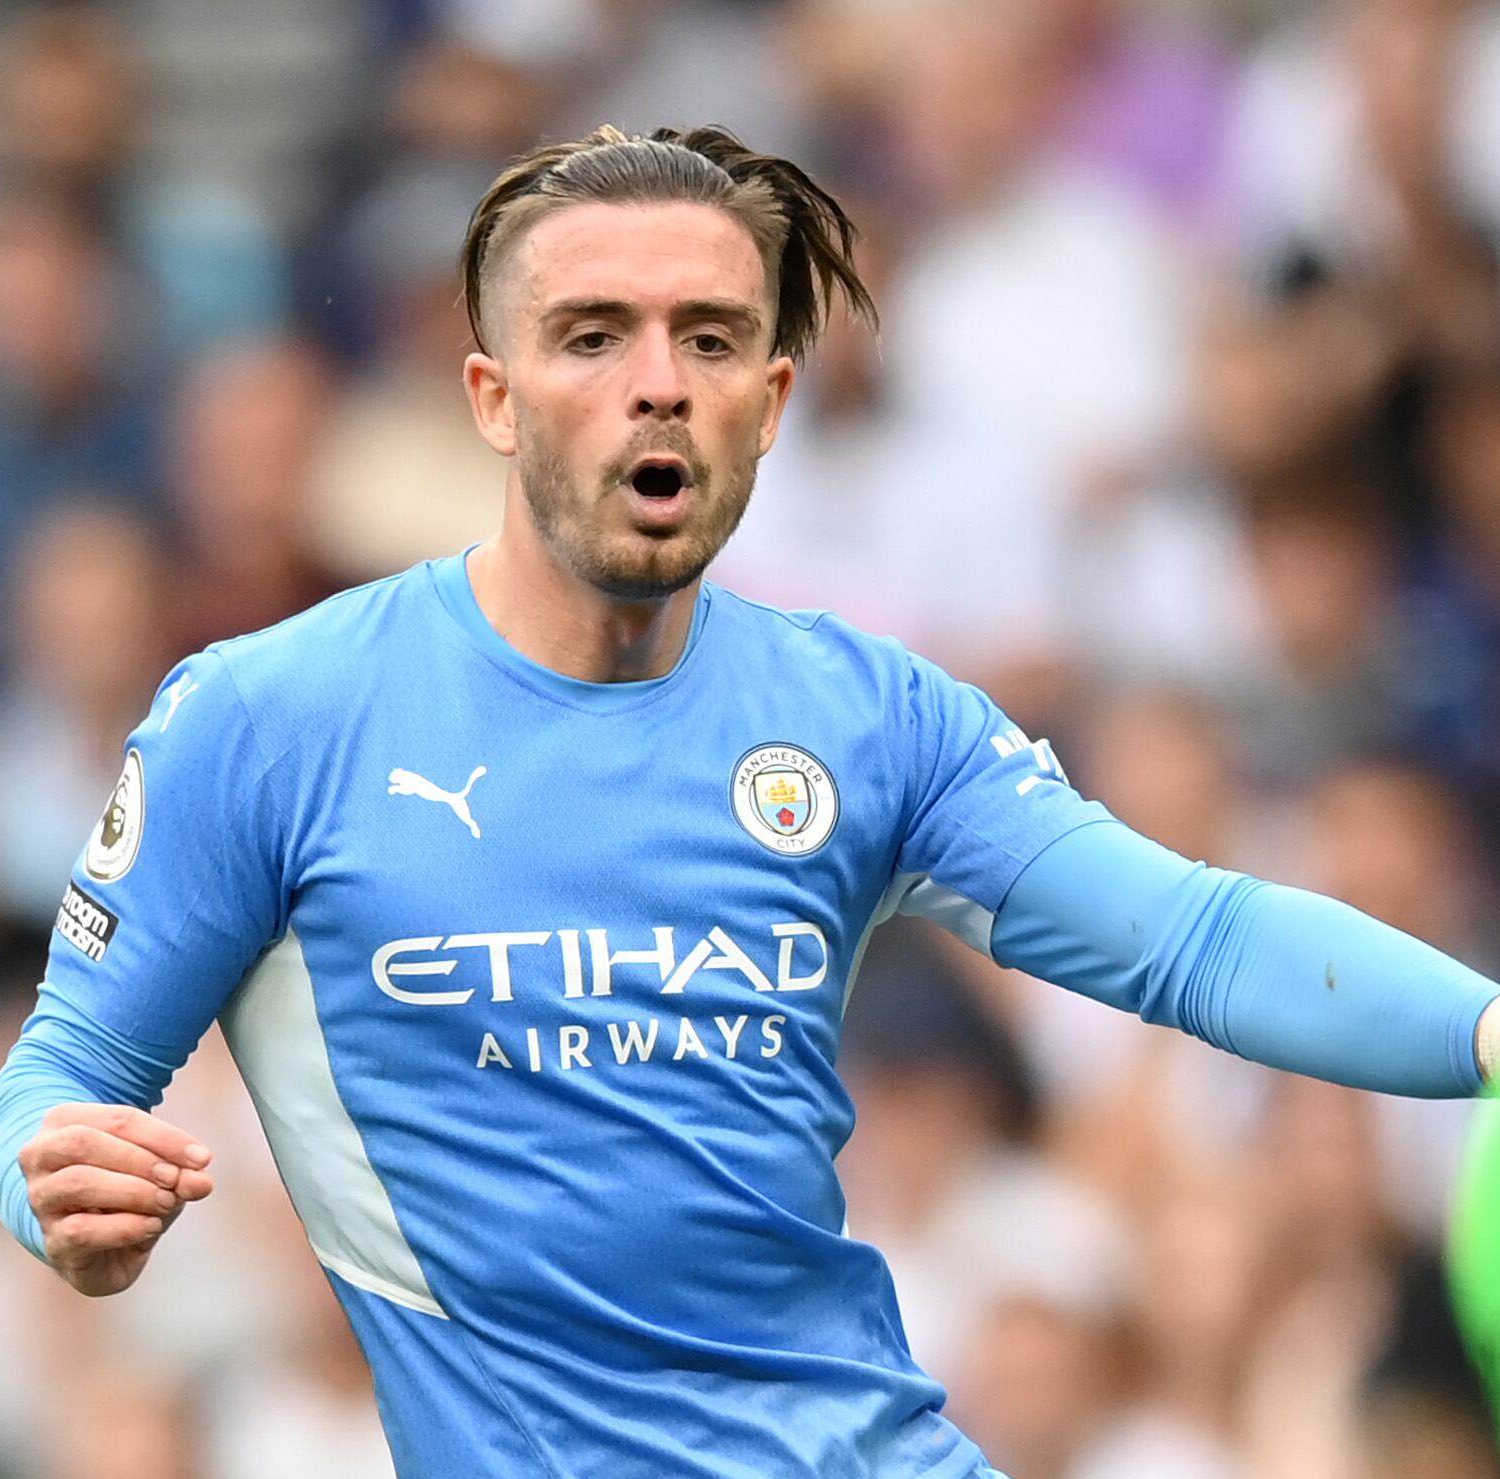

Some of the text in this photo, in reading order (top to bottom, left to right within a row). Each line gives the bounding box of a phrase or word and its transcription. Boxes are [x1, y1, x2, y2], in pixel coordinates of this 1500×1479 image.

[739, 751, 823, 787] MANCHESTER
[776, 839, 806, 848] CITY
[371, 921, 828, 1006] ETIHAD
[476, 1015, 786, 1073] AIRWAYS
